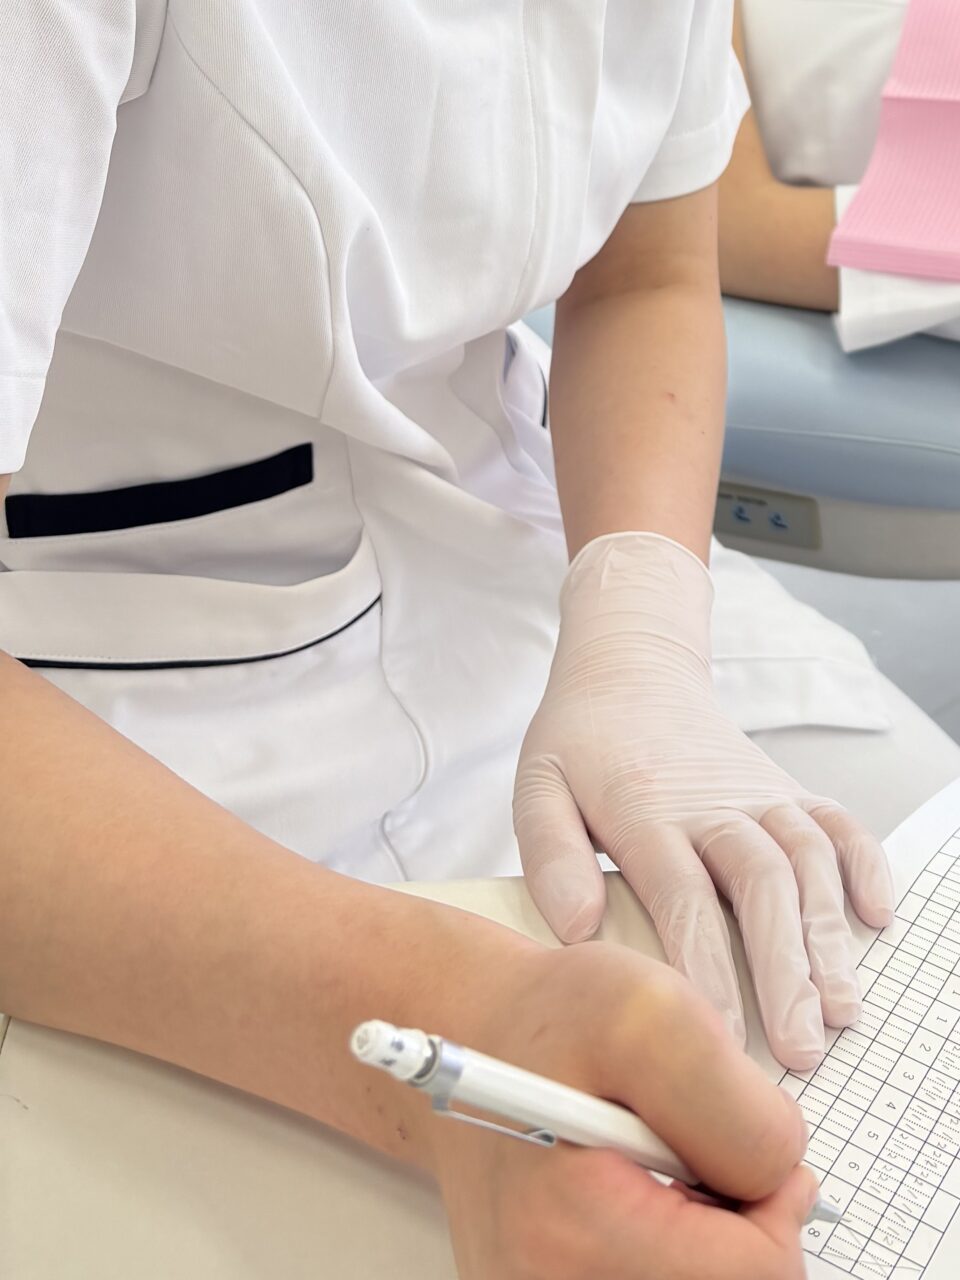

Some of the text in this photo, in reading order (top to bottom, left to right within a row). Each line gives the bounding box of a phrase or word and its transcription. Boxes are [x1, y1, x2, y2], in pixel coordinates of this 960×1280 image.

[919, 1043, 931, 1052] 2
[903, 1071, 915, 1080] 3
[886, 1102, 896, 1110] 4
[867, 1131, 879, 1140] 5
[848, 1161, 860, 1171] 6
[829, 1195, 841, 1204] 7
[808, 1228, 821, 1238] 8
